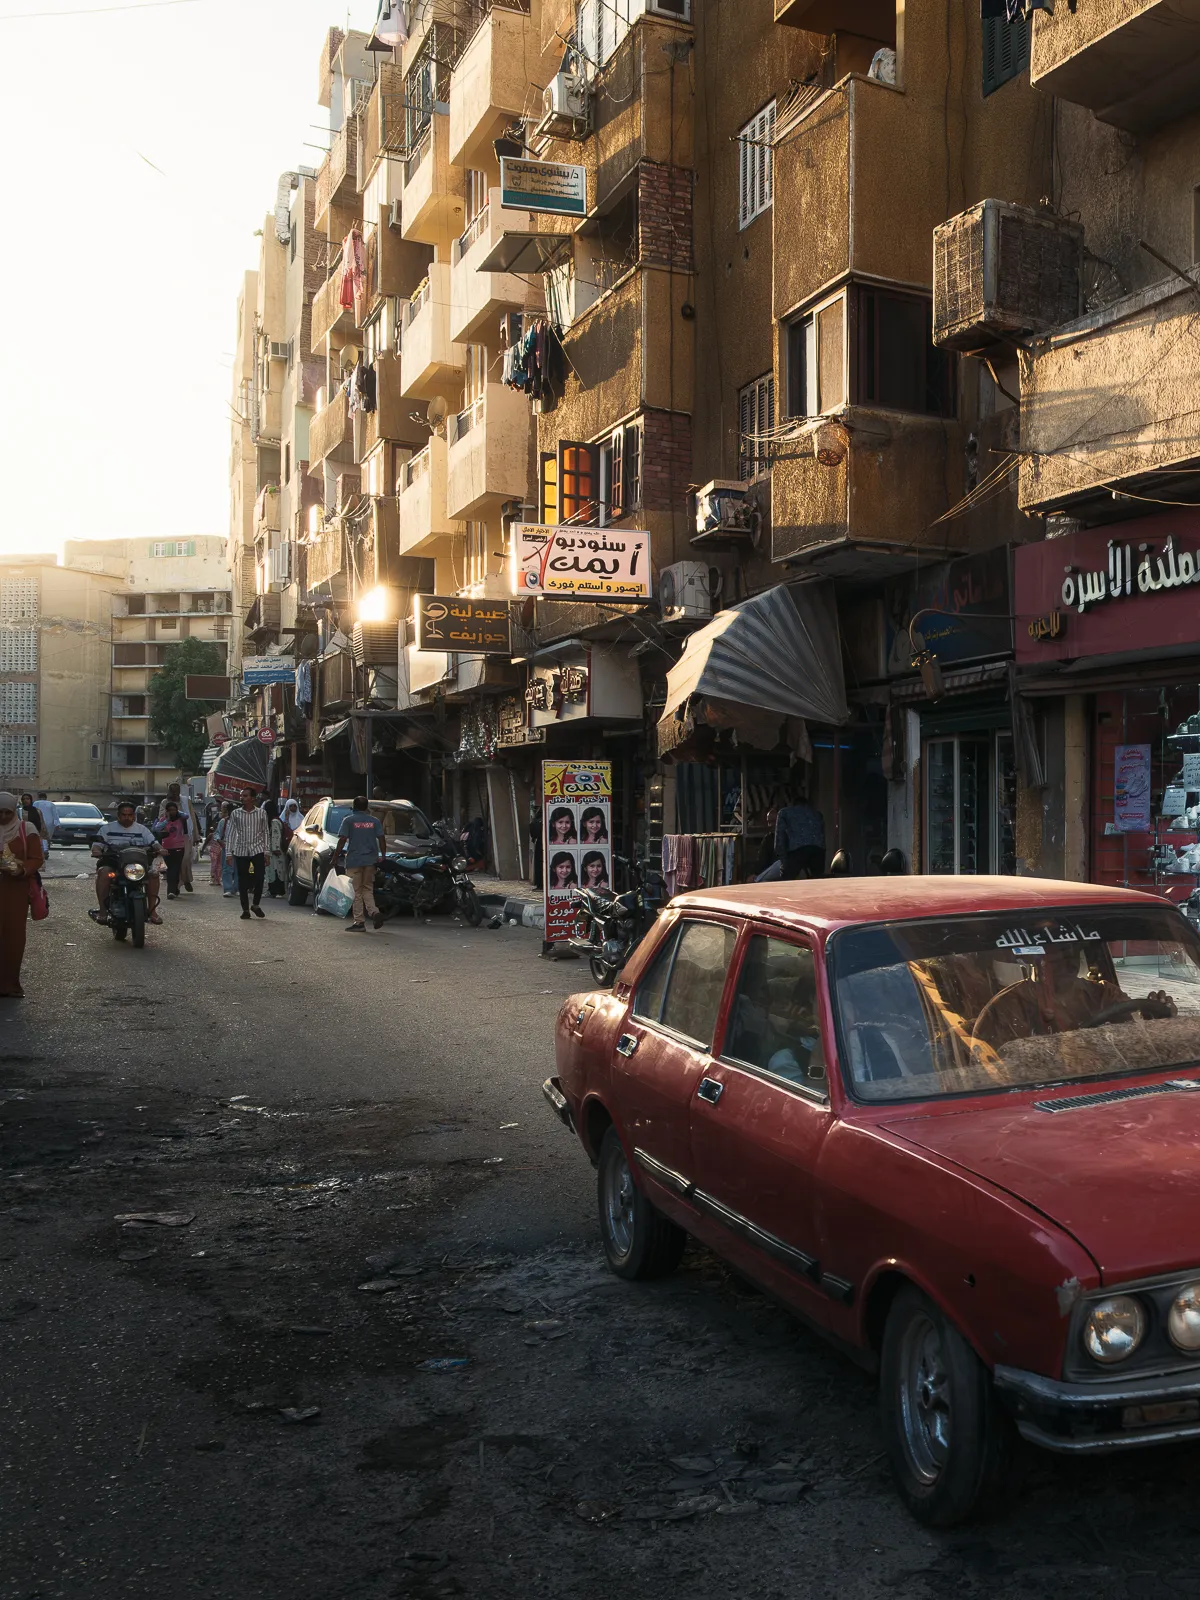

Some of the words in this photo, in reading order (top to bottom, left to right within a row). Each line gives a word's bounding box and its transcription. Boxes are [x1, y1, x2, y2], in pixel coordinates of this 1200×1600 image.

[555, 535, 626, 553] ستوديو
[449, 626, 508, 645] جوزيف
[550, 781, 558, 794] 2
